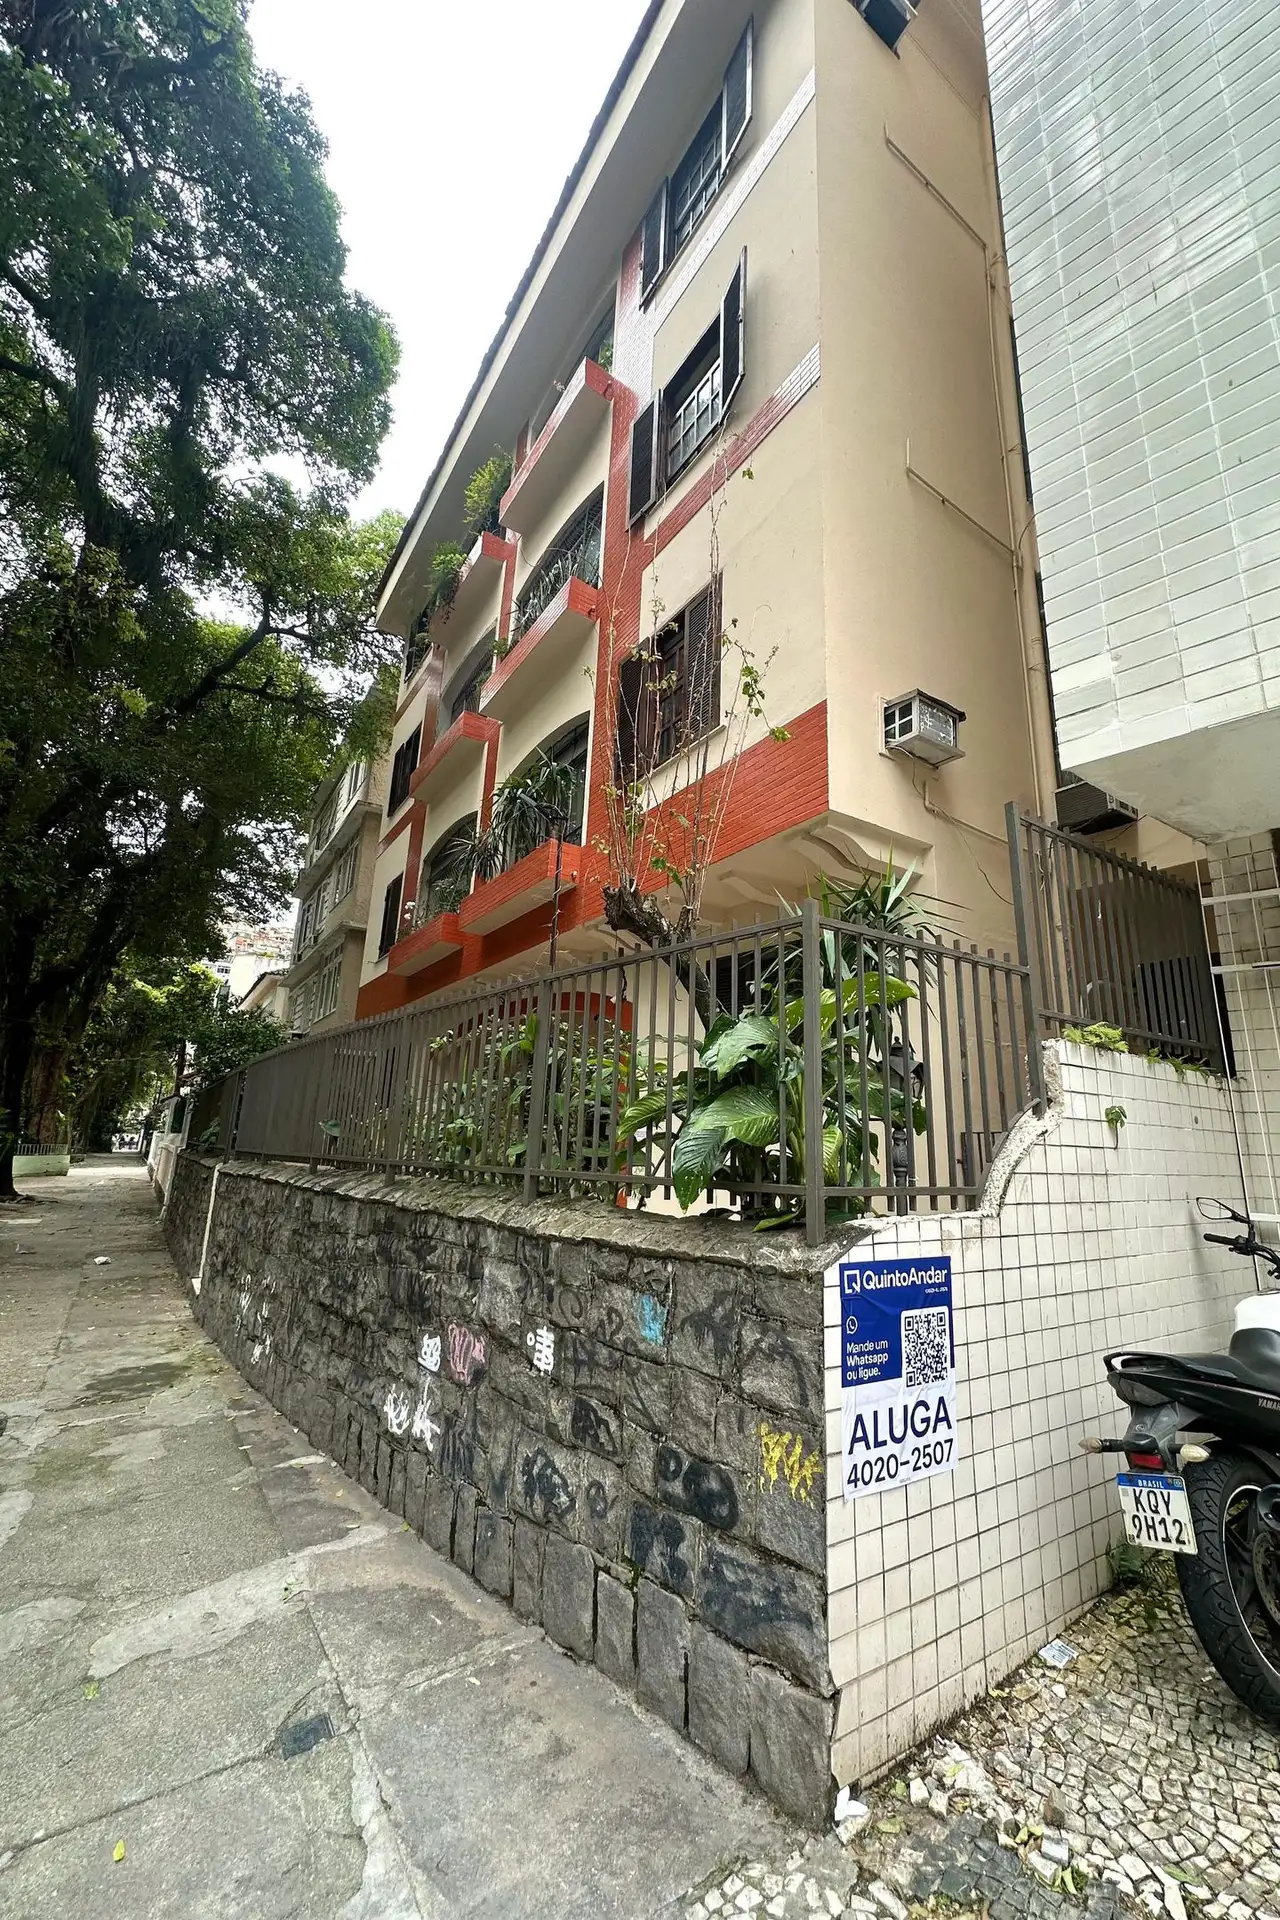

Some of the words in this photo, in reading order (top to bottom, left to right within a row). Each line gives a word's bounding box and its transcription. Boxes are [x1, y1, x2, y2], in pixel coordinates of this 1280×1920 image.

[862, 1266, 948, 1290] QuintoAndar
[846, 1340, 875, 1354] Mande
[875, 1339, 888, 1349] um
[846, 1352, 889, 1367] Whatsapp
[846, 1370, 857, 1380] ou
[858, 1367, 881, 1380] ligue.
[848, 1396, 952, 1456] ALUGA
[847, 1438, 954, 1489] 4020-2507
[1138, 1479, 1164, 1489] BRASIL
[1133, 1488, 1171, 1516] KQY
[1131, 1514, 1187, 1545] 9H12
